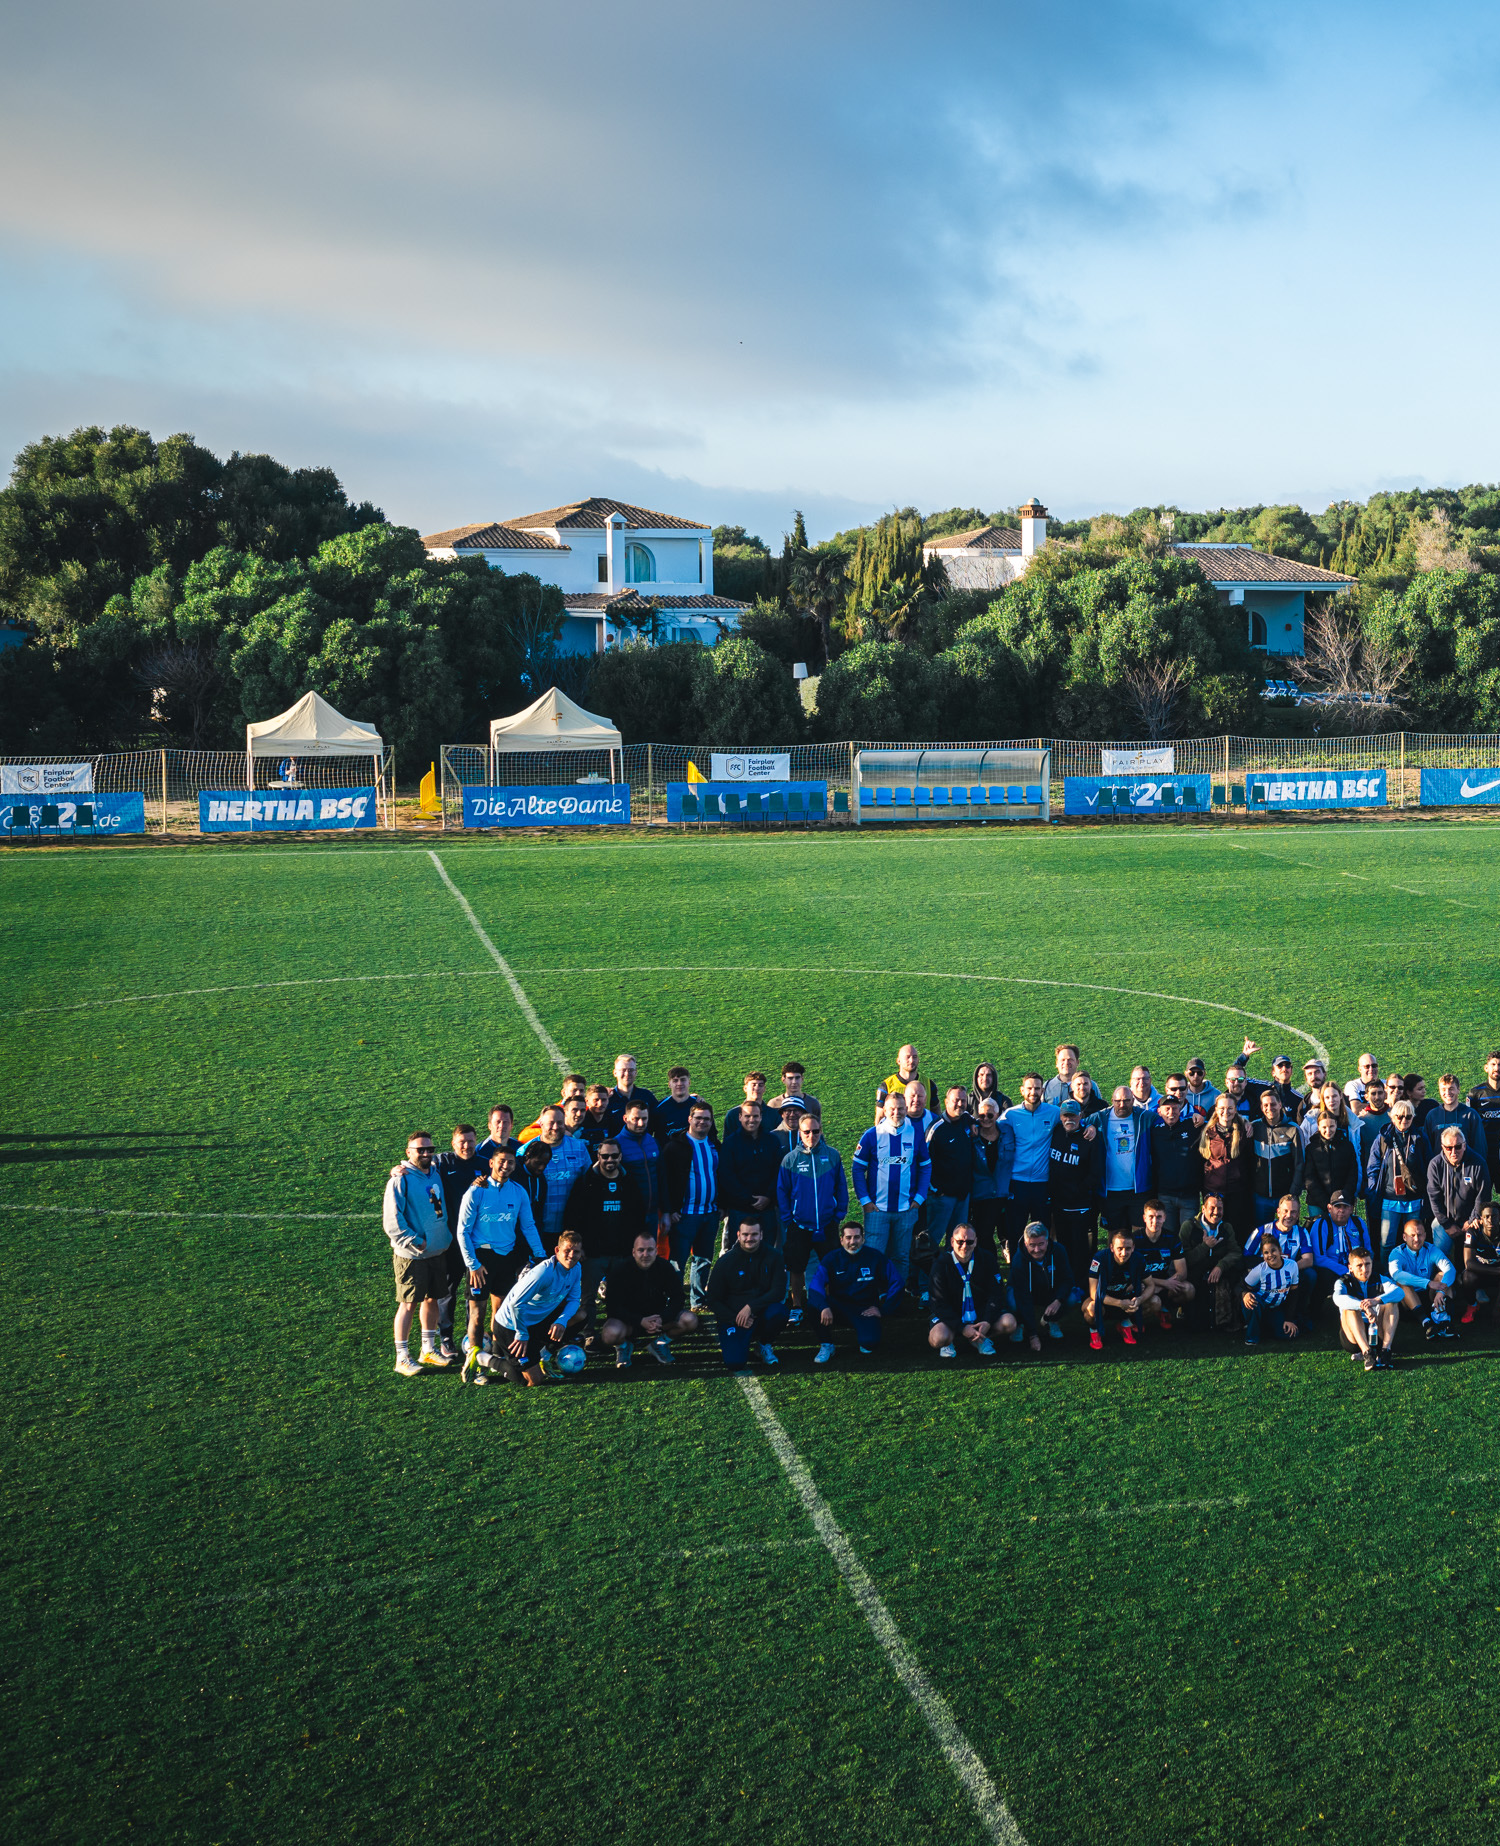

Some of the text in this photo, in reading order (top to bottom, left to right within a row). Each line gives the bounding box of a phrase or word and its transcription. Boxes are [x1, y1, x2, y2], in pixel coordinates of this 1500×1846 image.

[1342, 778, 1380, 799] BSC
[208, 797, 367, 822] HERTHA BSC
[472, 796, 623, 817] Die Alte Dame
[1050, 1148, 1080, 1166] ER LIN
